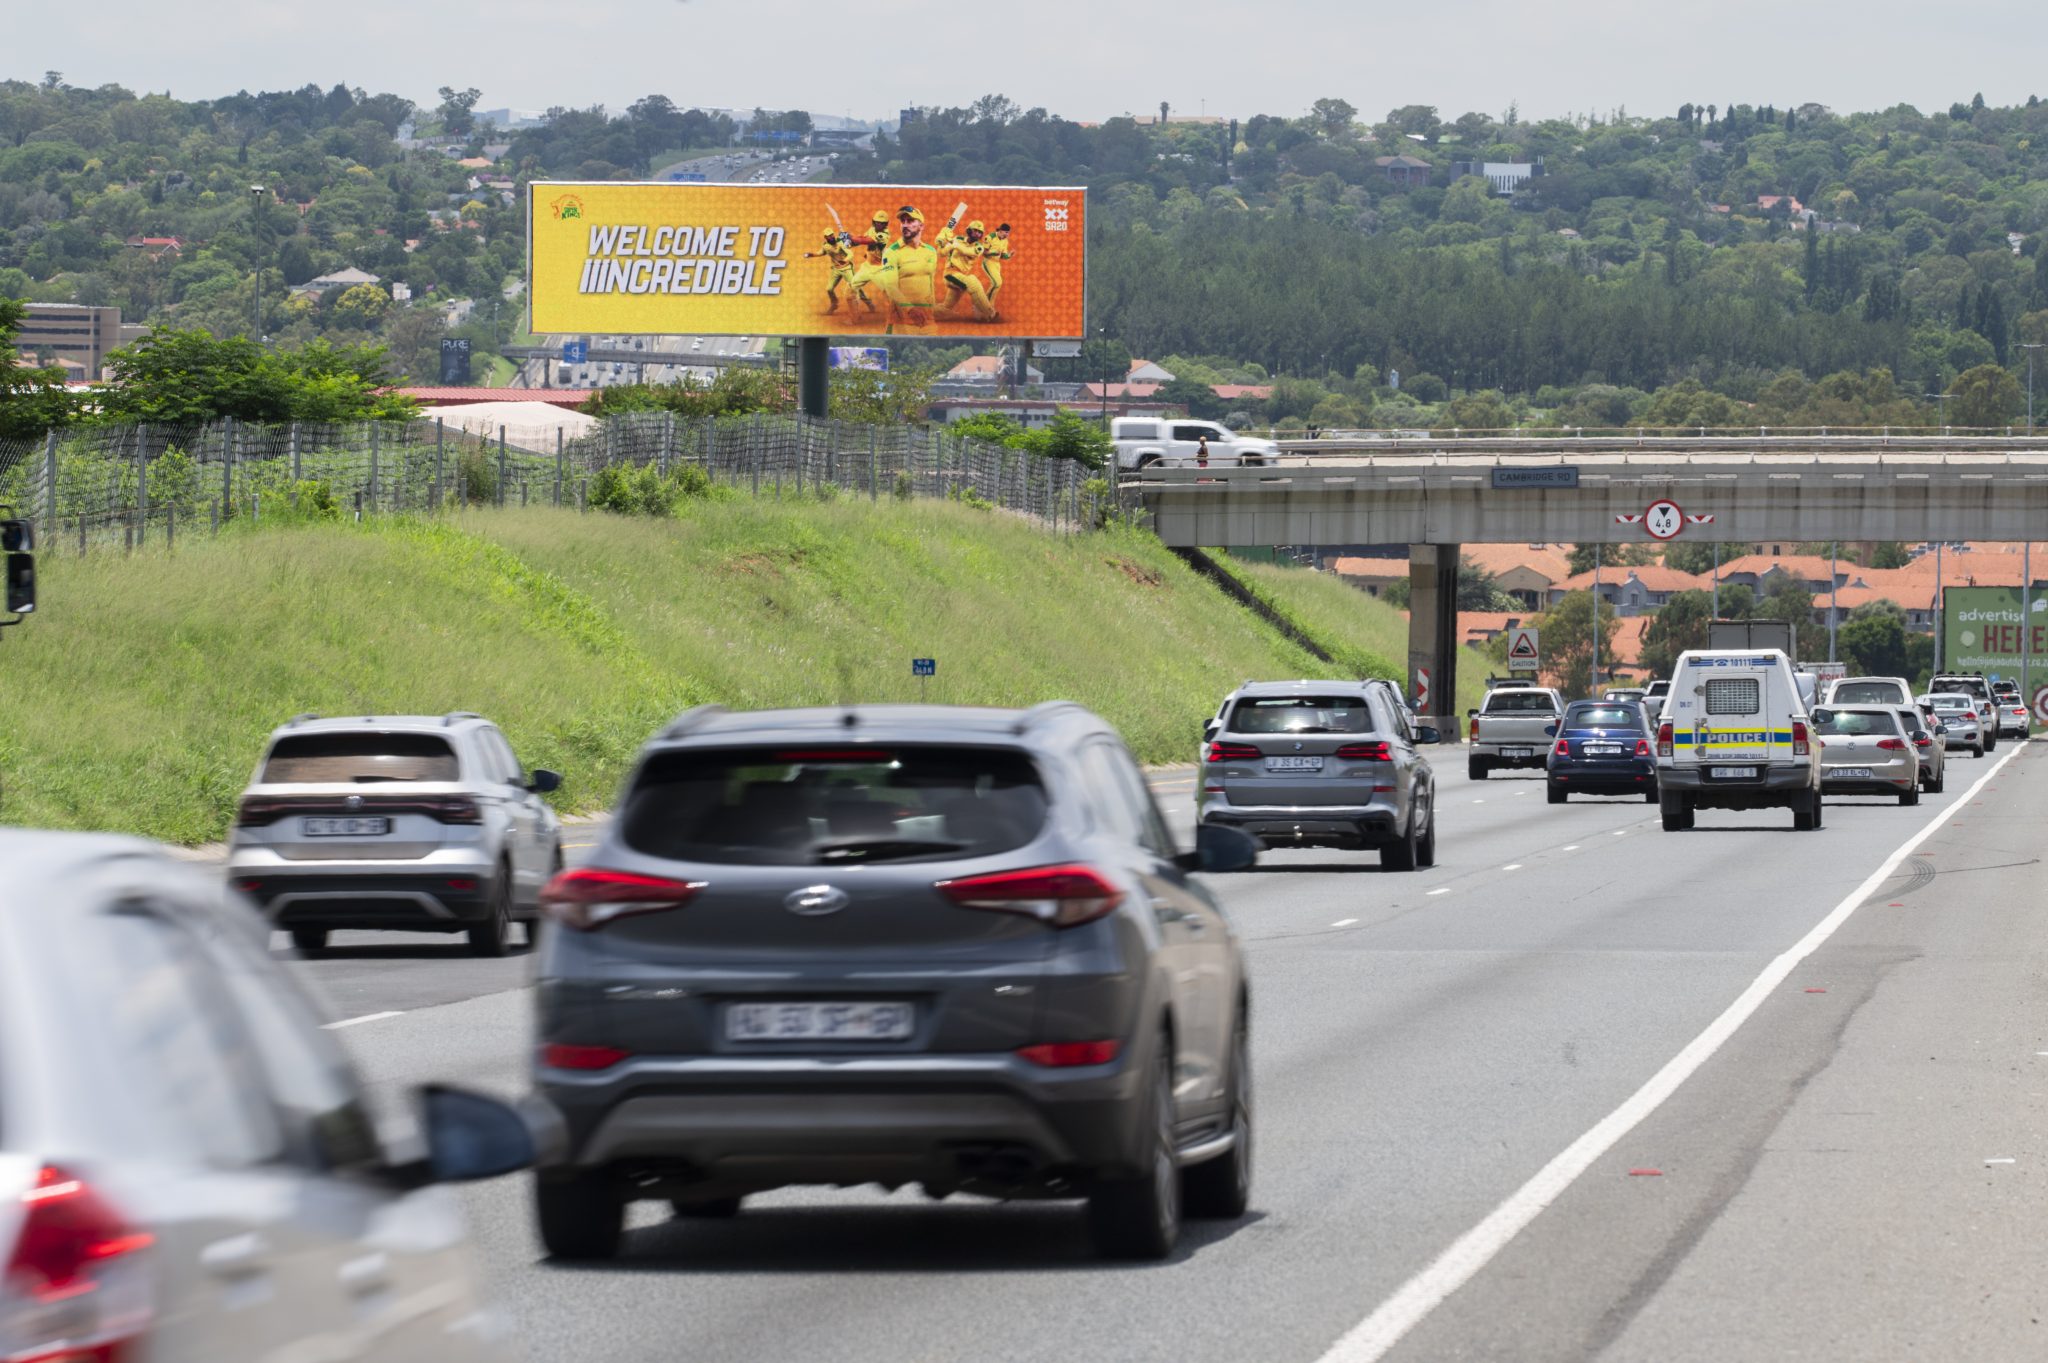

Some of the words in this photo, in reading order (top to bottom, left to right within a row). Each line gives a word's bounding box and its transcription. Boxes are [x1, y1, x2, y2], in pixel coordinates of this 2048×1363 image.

[588, 225, 740, 257] WELCOME
[748, 226, 785, 257] TO
[442, 339, 469, 350] PURE
[1499, 472, 1553, 482] CAMBRIDGE
[1557, 472, 1571, 481] RD
[1655, 518, 1672, 528] 4.8
[1730, 658, 1752, 666] 10111
[1707, 733, 1762, 743] POLICE
